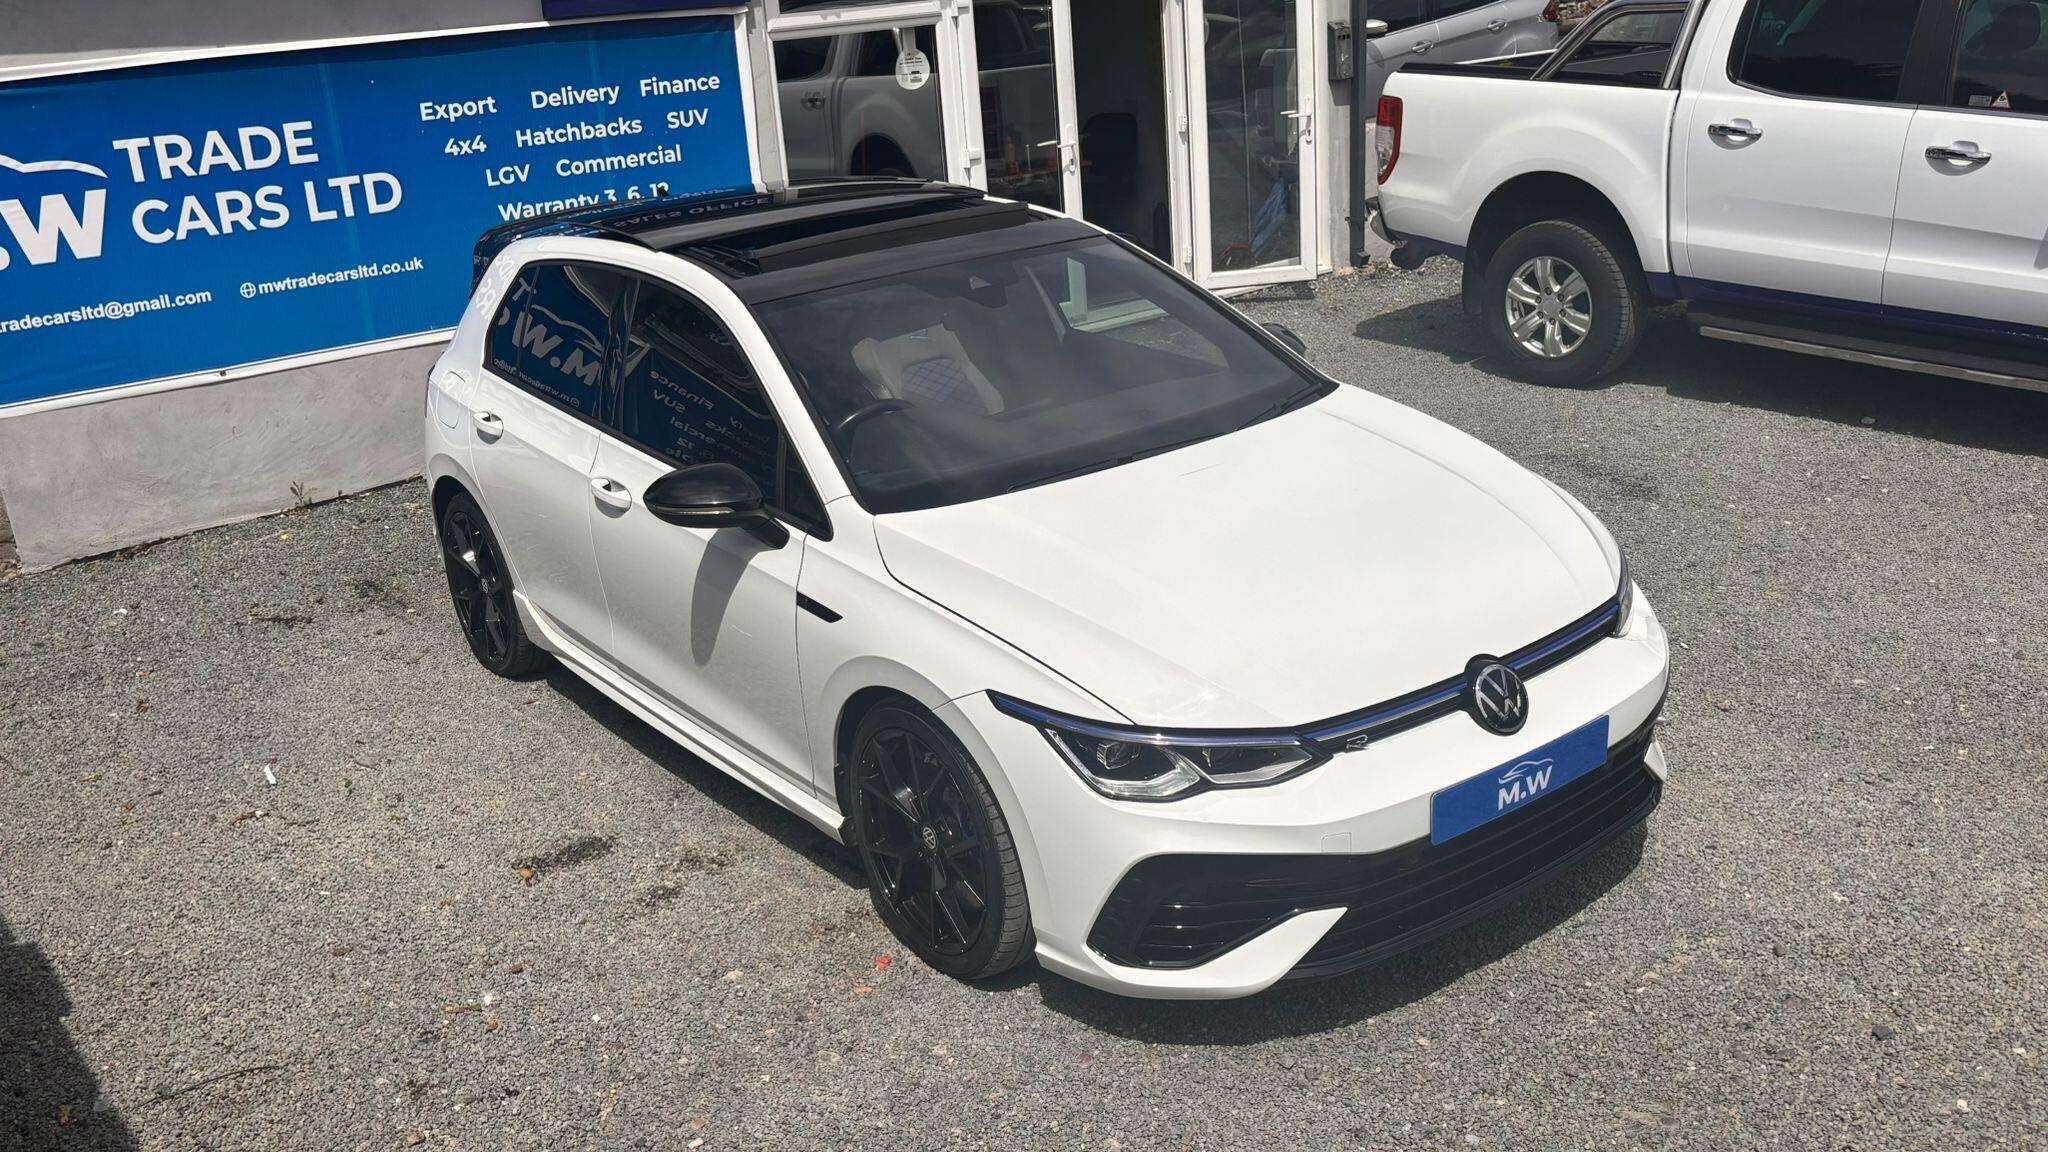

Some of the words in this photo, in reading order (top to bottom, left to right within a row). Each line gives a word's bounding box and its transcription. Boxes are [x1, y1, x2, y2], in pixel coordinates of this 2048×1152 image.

[420, 96, 498, 122] Export
[530, 85, 620, 109] Delivery
[639, 74, 720, 97] Finance
[112, 120, 319, 183] TRADE
[444, 134, 487, 156] 4x4
[516, 118, 643, 147] Hatchbacks
[666, 108, 709, 130] SUV
[485, 164, 531, 187] LGV
[555, 144, 682, 178] Commercial
[132, 185, 290, 244] CARS
[304, 172, 402, 222] LTD
[498, 194, 599, 221] Warranty
[258, 256, 424, 295] mwtradecarsltd.co.uk
[1498, 766, 1552, 810] M.W
